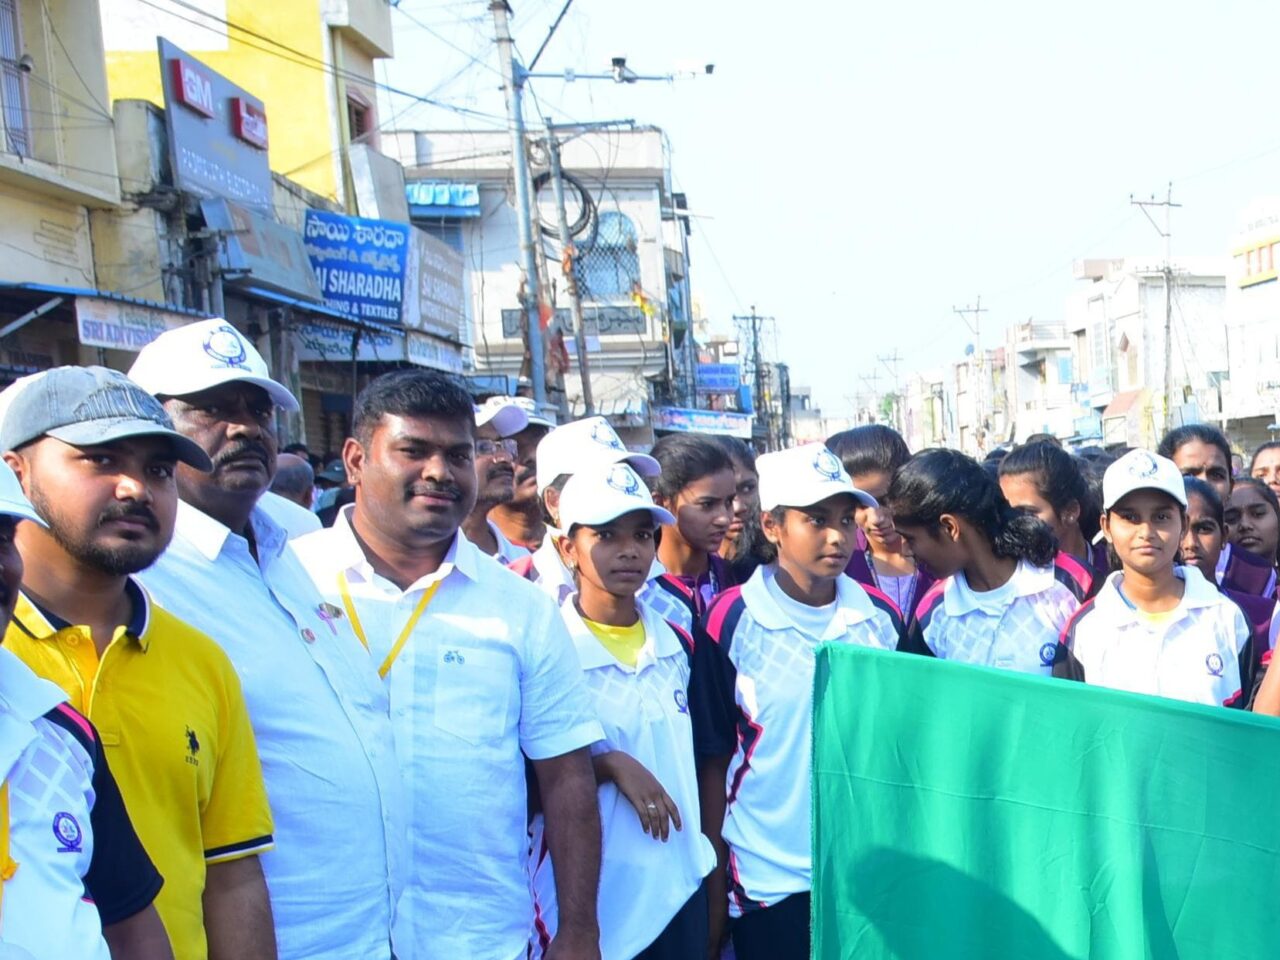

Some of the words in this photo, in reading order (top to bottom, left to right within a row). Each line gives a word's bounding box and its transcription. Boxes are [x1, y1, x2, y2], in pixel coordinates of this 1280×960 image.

[184, 67, 213, 112] GM
[328, 269, 401, 302] SHARADHA
[361, 304, 398, 321] TEXTILES
